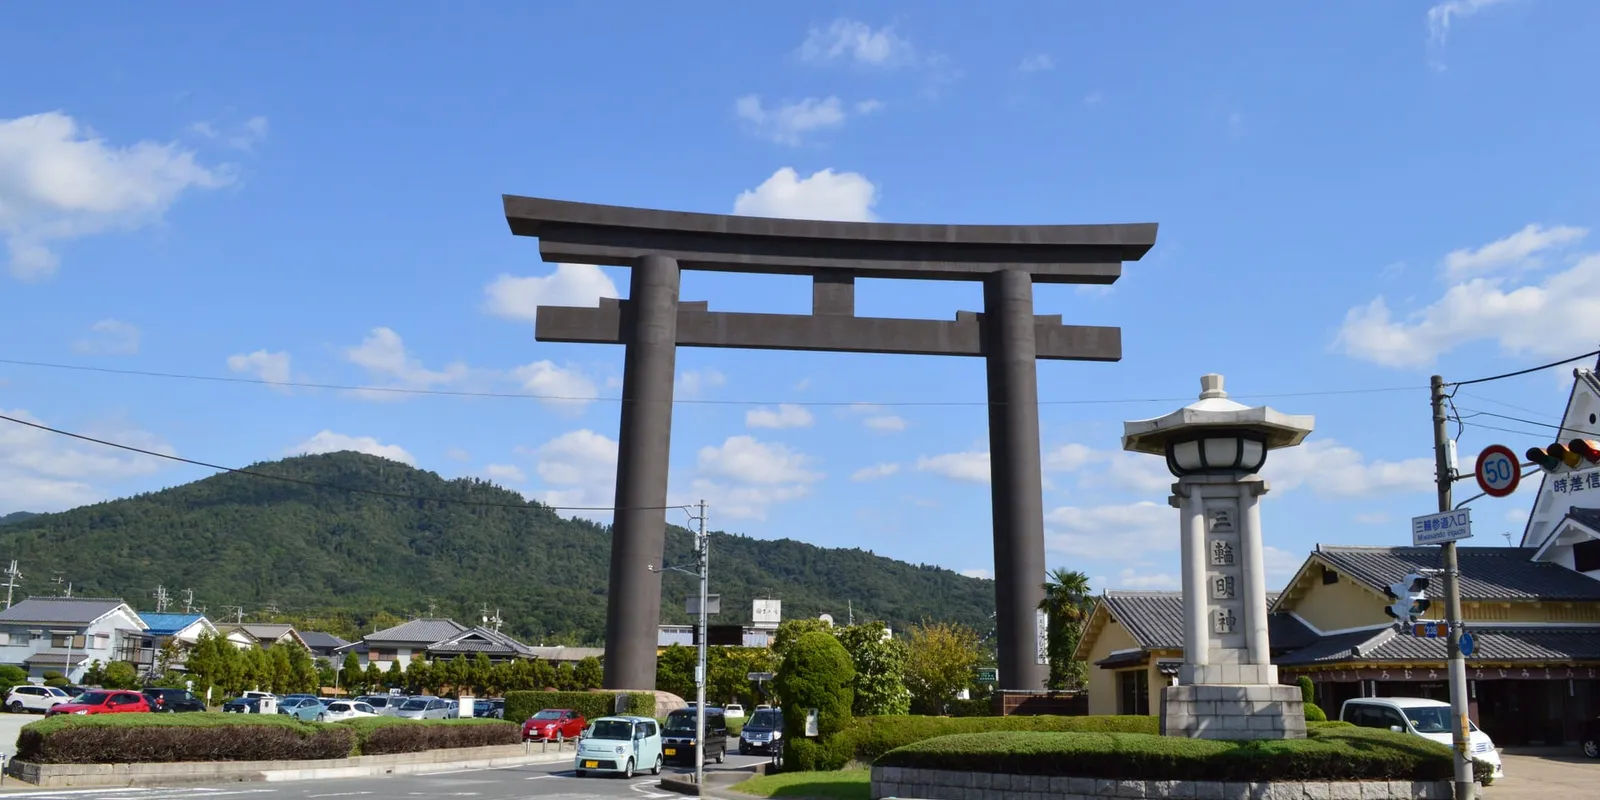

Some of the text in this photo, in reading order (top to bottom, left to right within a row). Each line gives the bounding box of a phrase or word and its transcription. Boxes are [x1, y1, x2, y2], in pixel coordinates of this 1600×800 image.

[1484, 459, 1511, 483] 50
[1416, 513, 1466, 533] 三輪参道入口
[1213, 511, 1237, 632] 三輪明神
